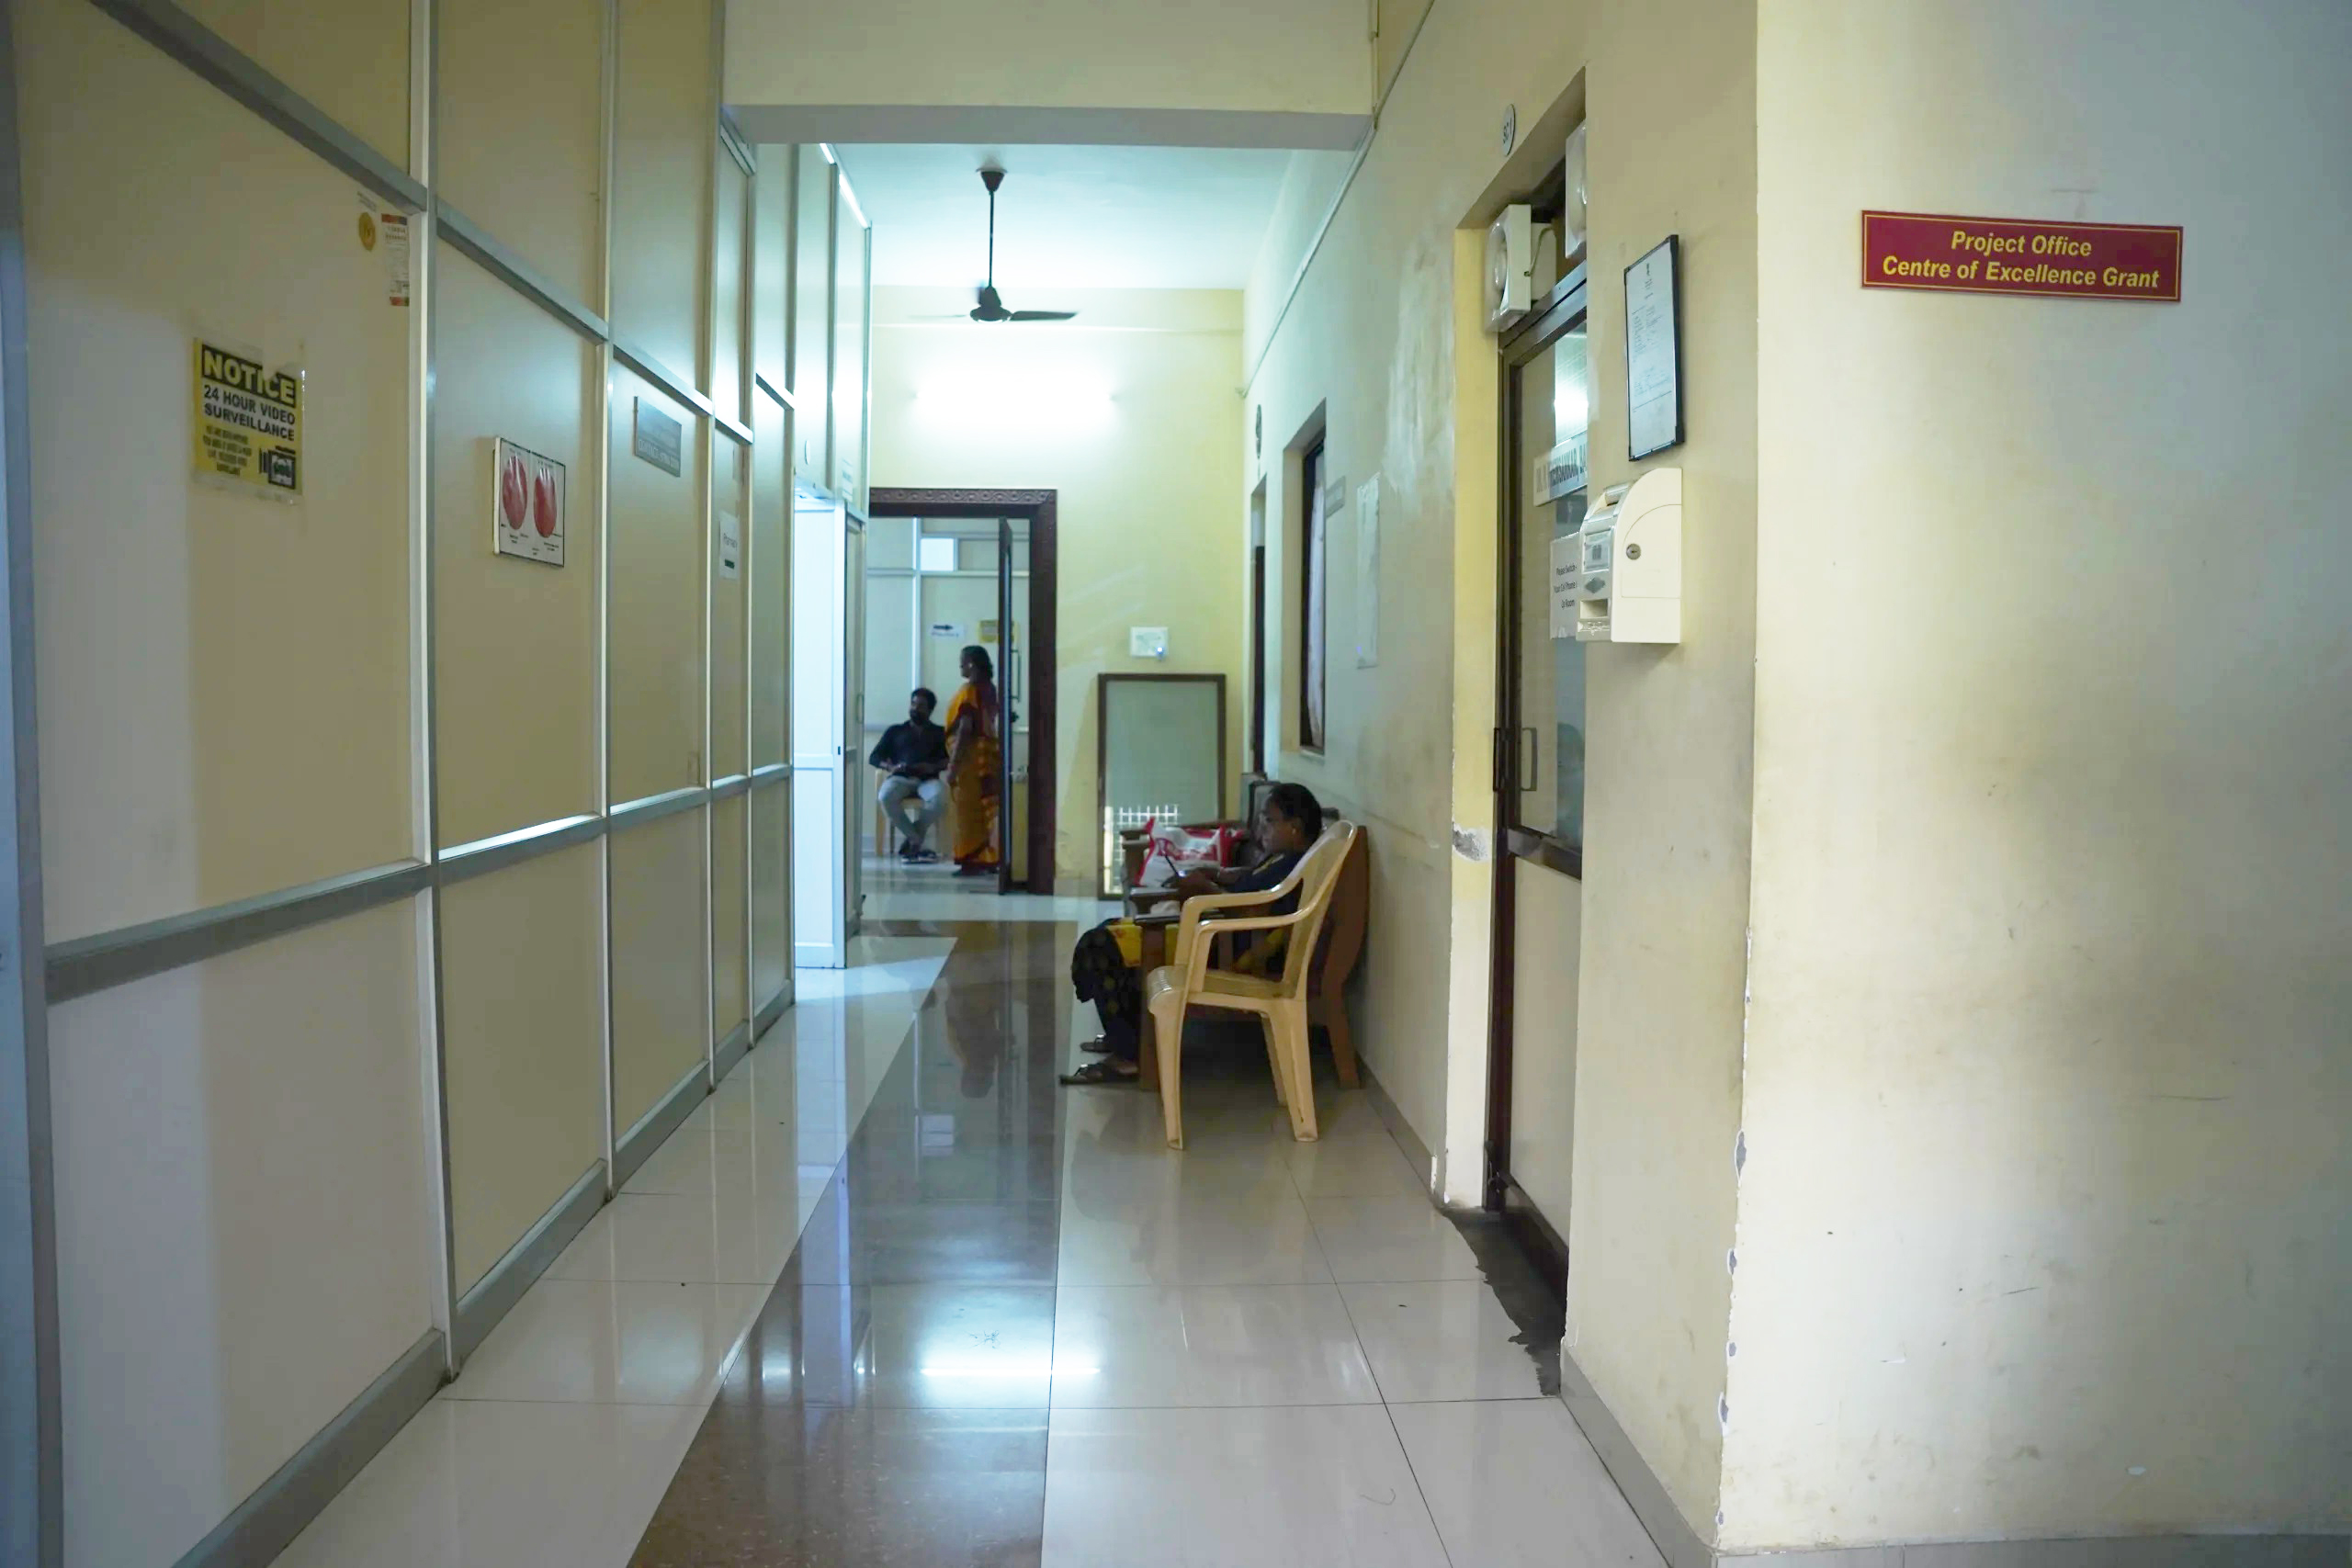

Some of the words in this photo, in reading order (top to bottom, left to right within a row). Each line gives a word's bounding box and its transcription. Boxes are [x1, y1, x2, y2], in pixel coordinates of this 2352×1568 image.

[1951, 231, 2025, 257] Project
[2031, 234, 2092, 256] Office
[1883, 255, 1951, 279] Centre
[1957, 260, 1979, 279] of
[1985, 262, 2096, 287] Excellence
[2103, 266, 2159, 288] Grant
[204, 350, 295, 404] NOTICE
[204, 385, 220, 402] 24
[223, 390, 256, 413] HOUR
[260, 401, 296, 425] VIDEO
[204, 402, 295, 441] SURVEILLANCE
